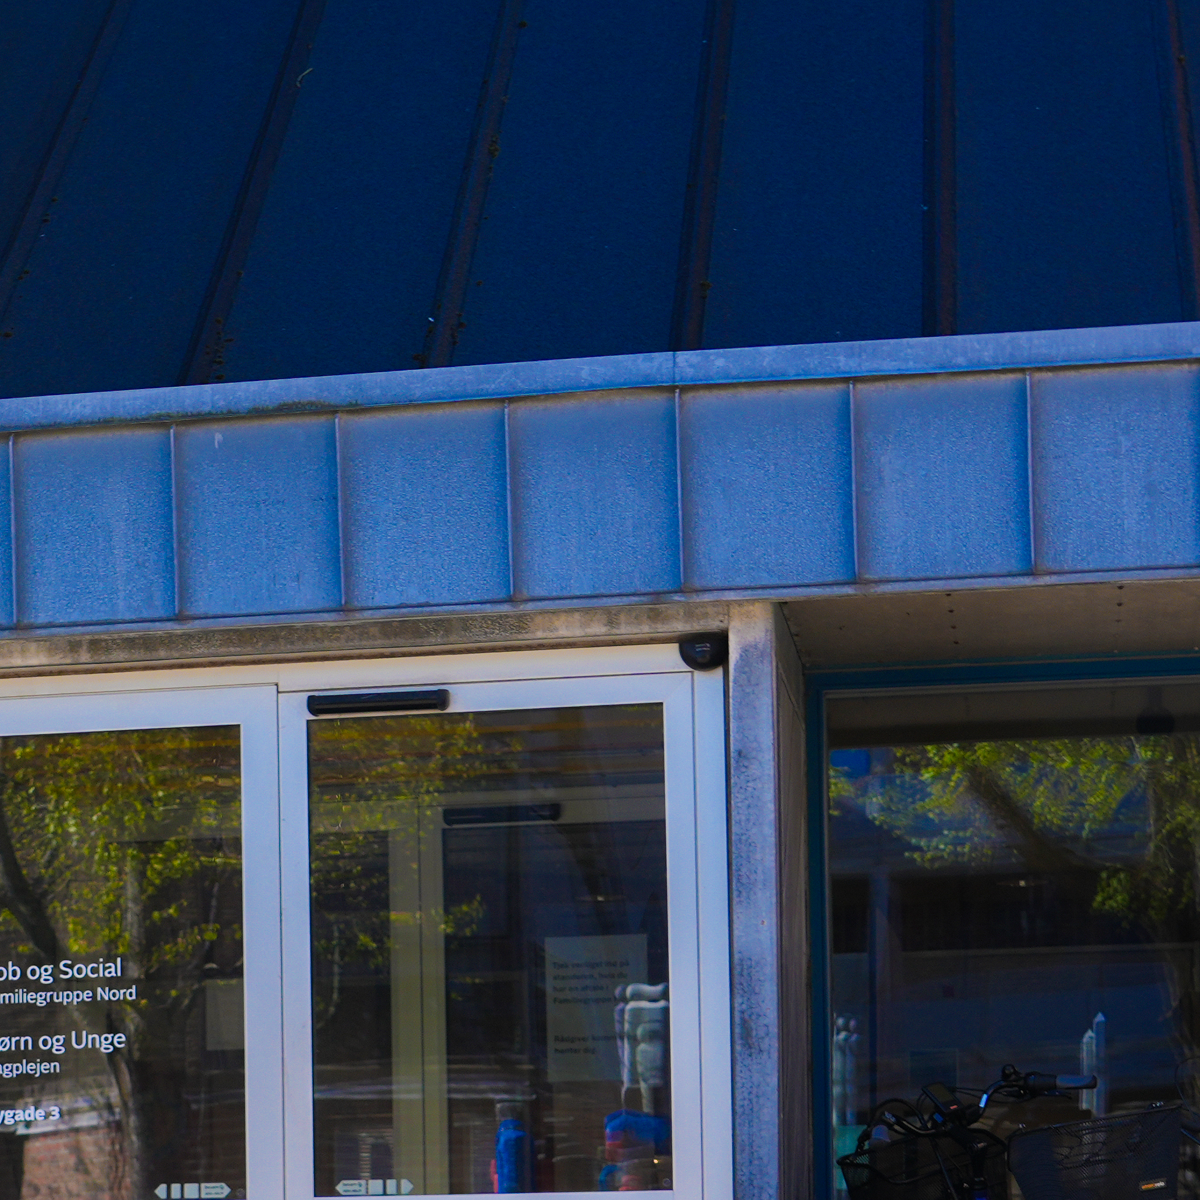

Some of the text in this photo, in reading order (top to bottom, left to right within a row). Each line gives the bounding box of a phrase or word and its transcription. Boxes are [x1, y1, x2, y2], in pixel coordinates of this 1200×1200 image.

[26, 965, 54, 984] og
[59, 958, 122, 979] Social
[97, 985, 137, 1001] Nord
[38, 1035, 66, 1054] og
[71, 1030, 127, 1052] Unge
[49, 1105, 61, 1120] 3
